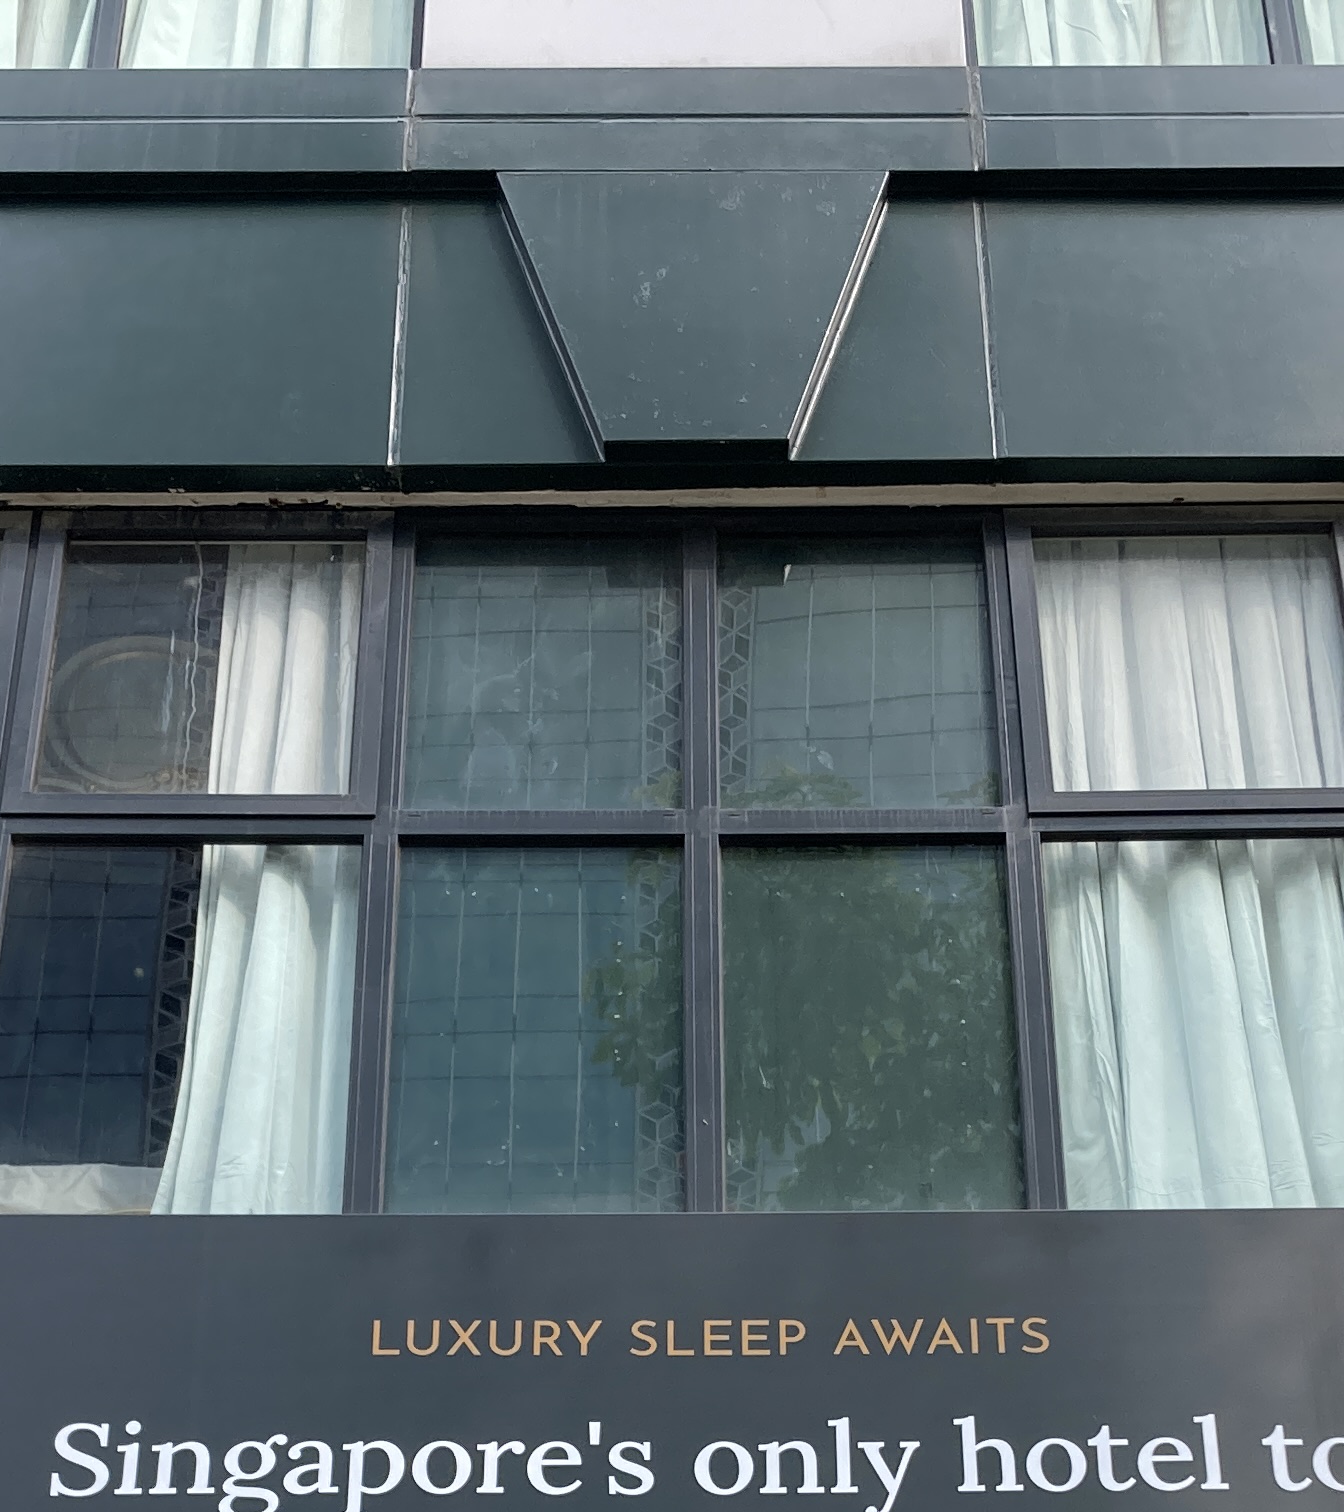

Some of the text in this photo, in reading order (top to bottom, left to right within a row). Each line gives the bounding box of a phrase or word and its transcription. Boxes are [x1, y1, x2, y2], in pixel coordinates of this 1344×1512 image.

[371, 1316, 1051, 1357] LUXURY SLEEP AWAITS
[951, 1412, 1231, 1494] hotel
